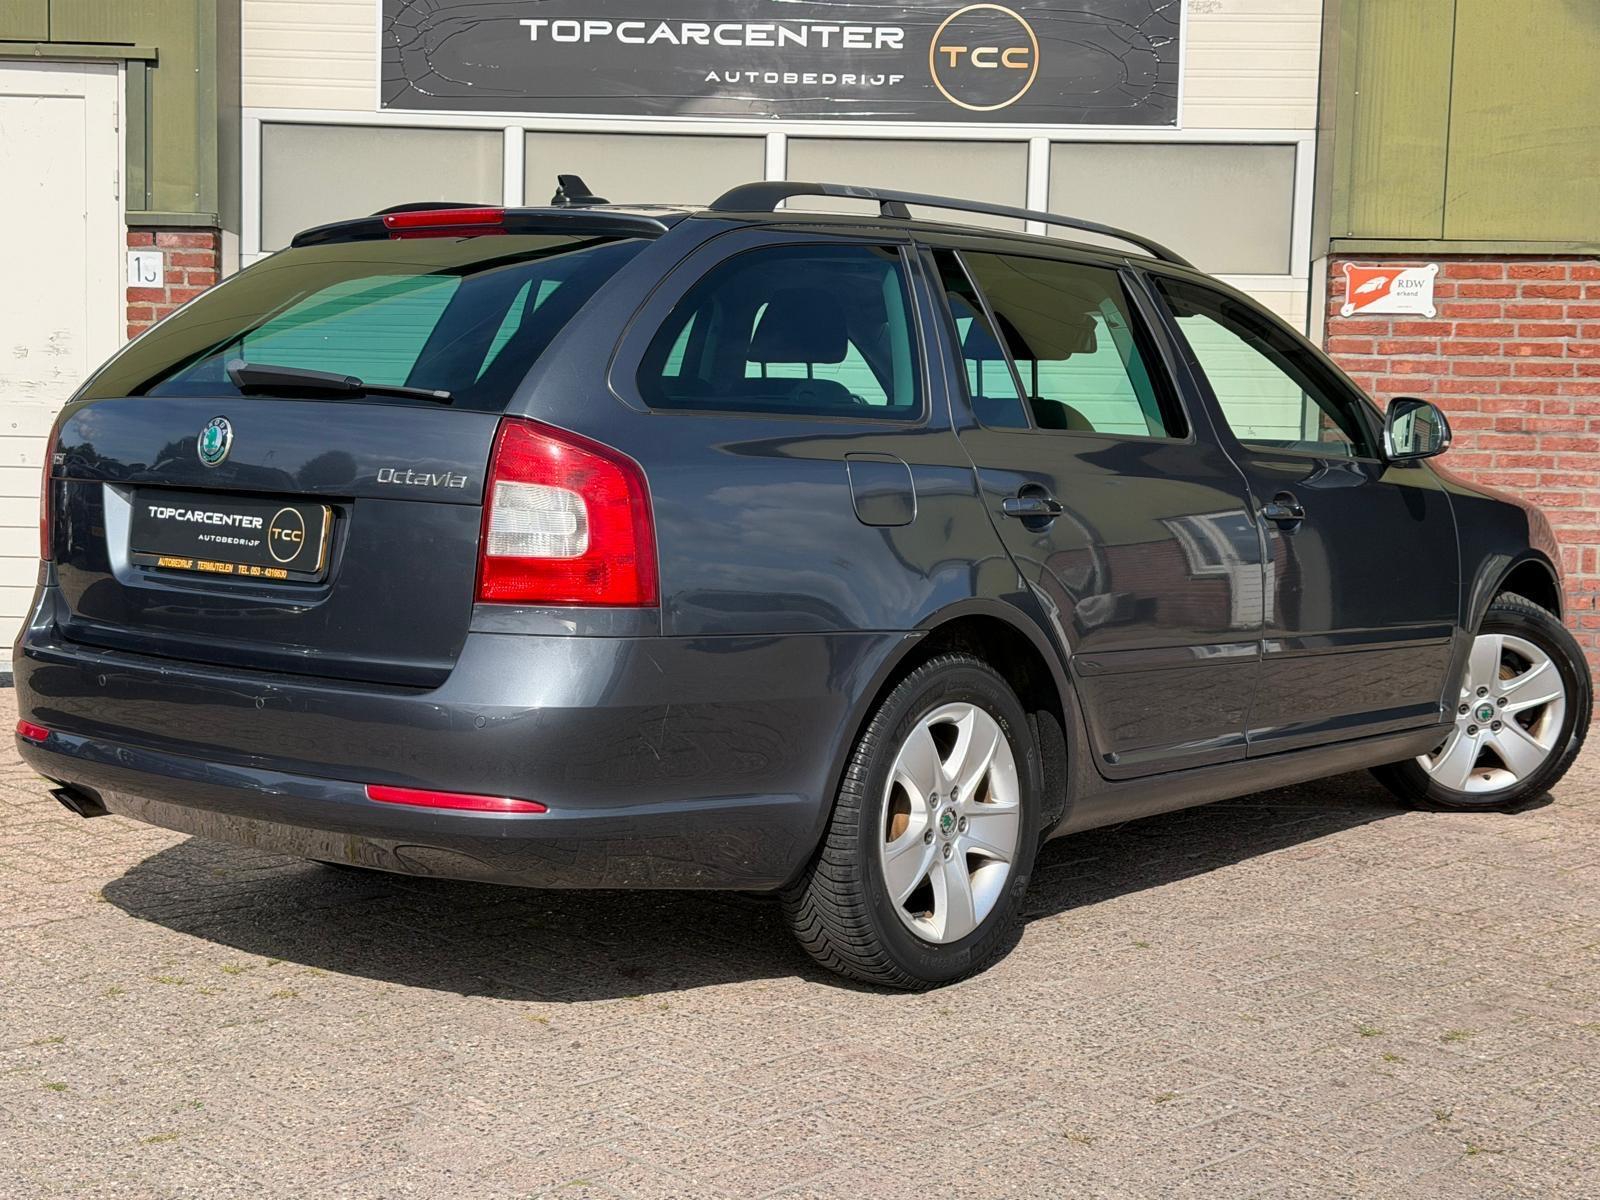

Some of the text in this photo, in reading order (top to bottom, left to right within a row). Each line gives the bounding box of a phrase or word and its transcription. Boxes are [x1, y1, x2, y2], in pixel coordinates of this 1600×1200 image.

[519, 18, 904, 50] TOPCARCENTER
[939, 45, 1030, 70] TCC
[705, 70, 905, 86] AUTOBEDRIJF
[1398, 279, 1425, 288] RDW
[376, 467, 468, 489] Octavia
[148, 506, 263, 529] TOPCARCENTER
[198, 534, 261, 546] AUTOBEDRIJF
[272, 528, 302, 542] TCC
[157, 557, 193, 569] AUTOBEDRIJF
